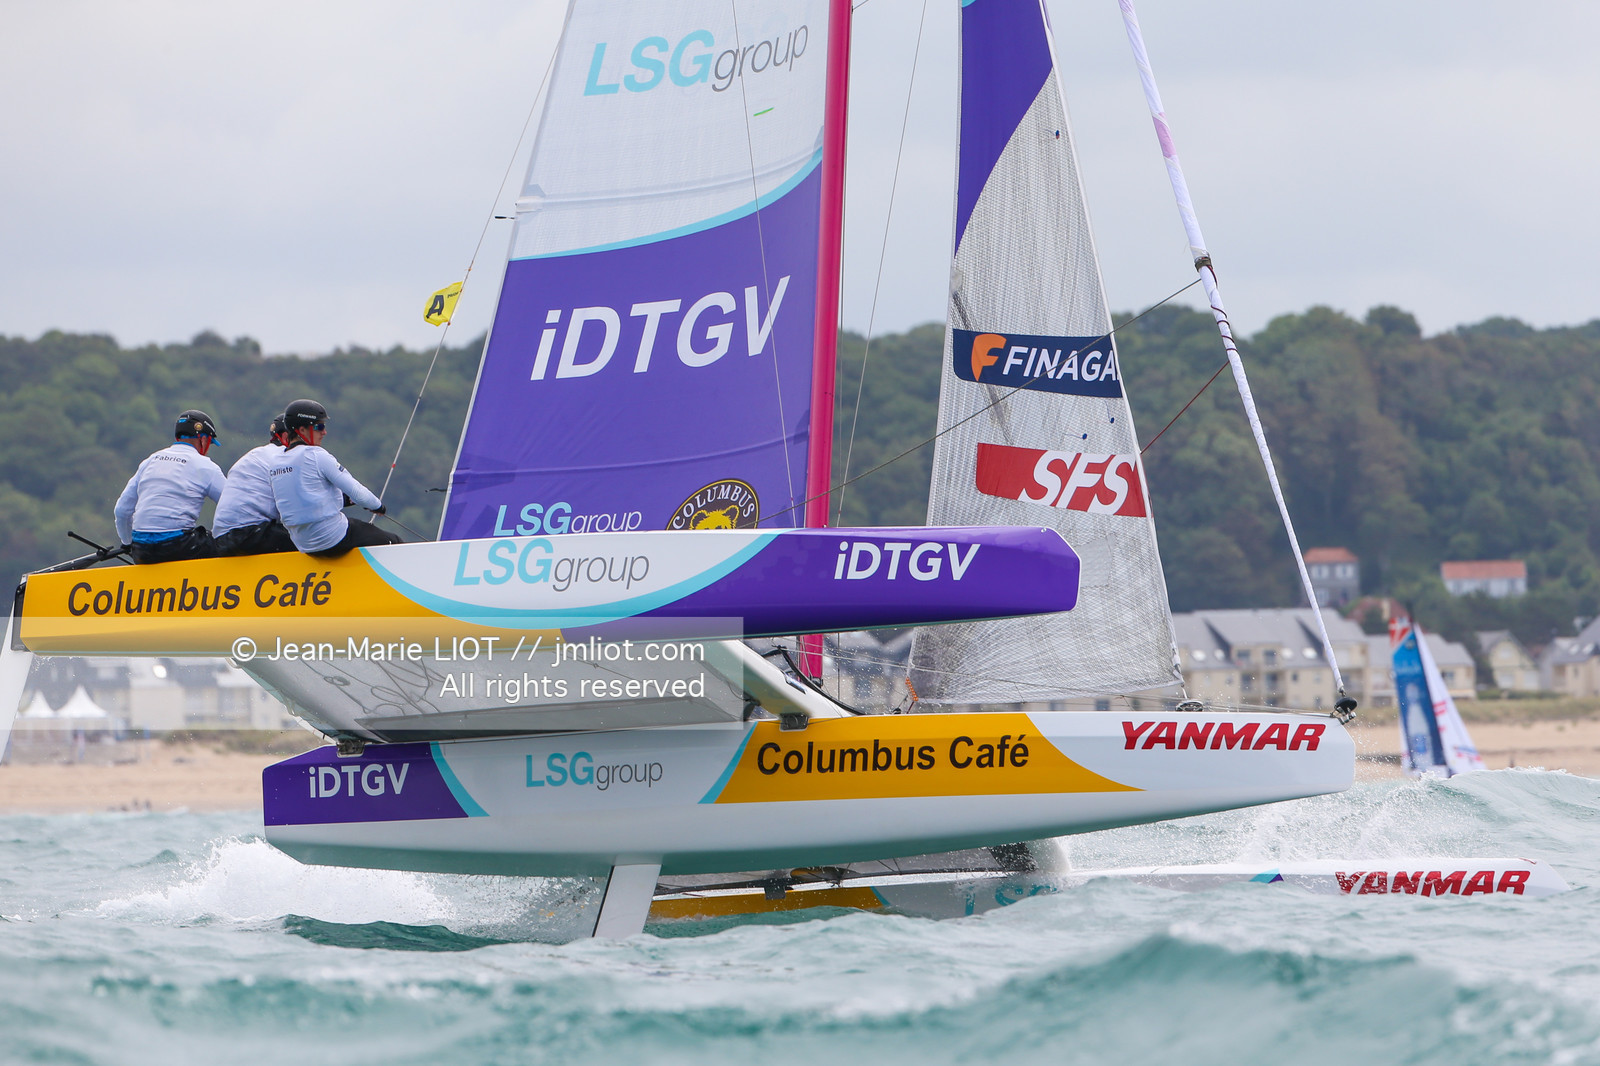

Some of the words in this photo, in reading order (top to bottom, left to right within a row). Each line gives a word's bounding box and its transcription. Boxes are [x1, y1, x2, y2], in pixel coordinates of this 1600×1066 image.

[426, 294, 445, 319] A
[530, 275, 791, 381] iDTGV
[1002, 345, 1121, 382] FINAGA
[154, 454, 187, 465] Fabrice
[269, 465, 293, 477] Calliste
[1016, 450, 1139, 516] SFS
[672, 484, 755, 530] COLUMBUS
[834, 541, 981, 581] iDTGV
[67, 578, 241, 616] Columbus
[254, 571, 332, 608] Café
[757, 739, 936, 775] Columbus
[948, 734, 1030, 768] Café
[1121, 721, 1326, 751] YANMAR
[309, 763, 410, 798] iDTGV
[1335, 871, 1531, 897] YANMAR
